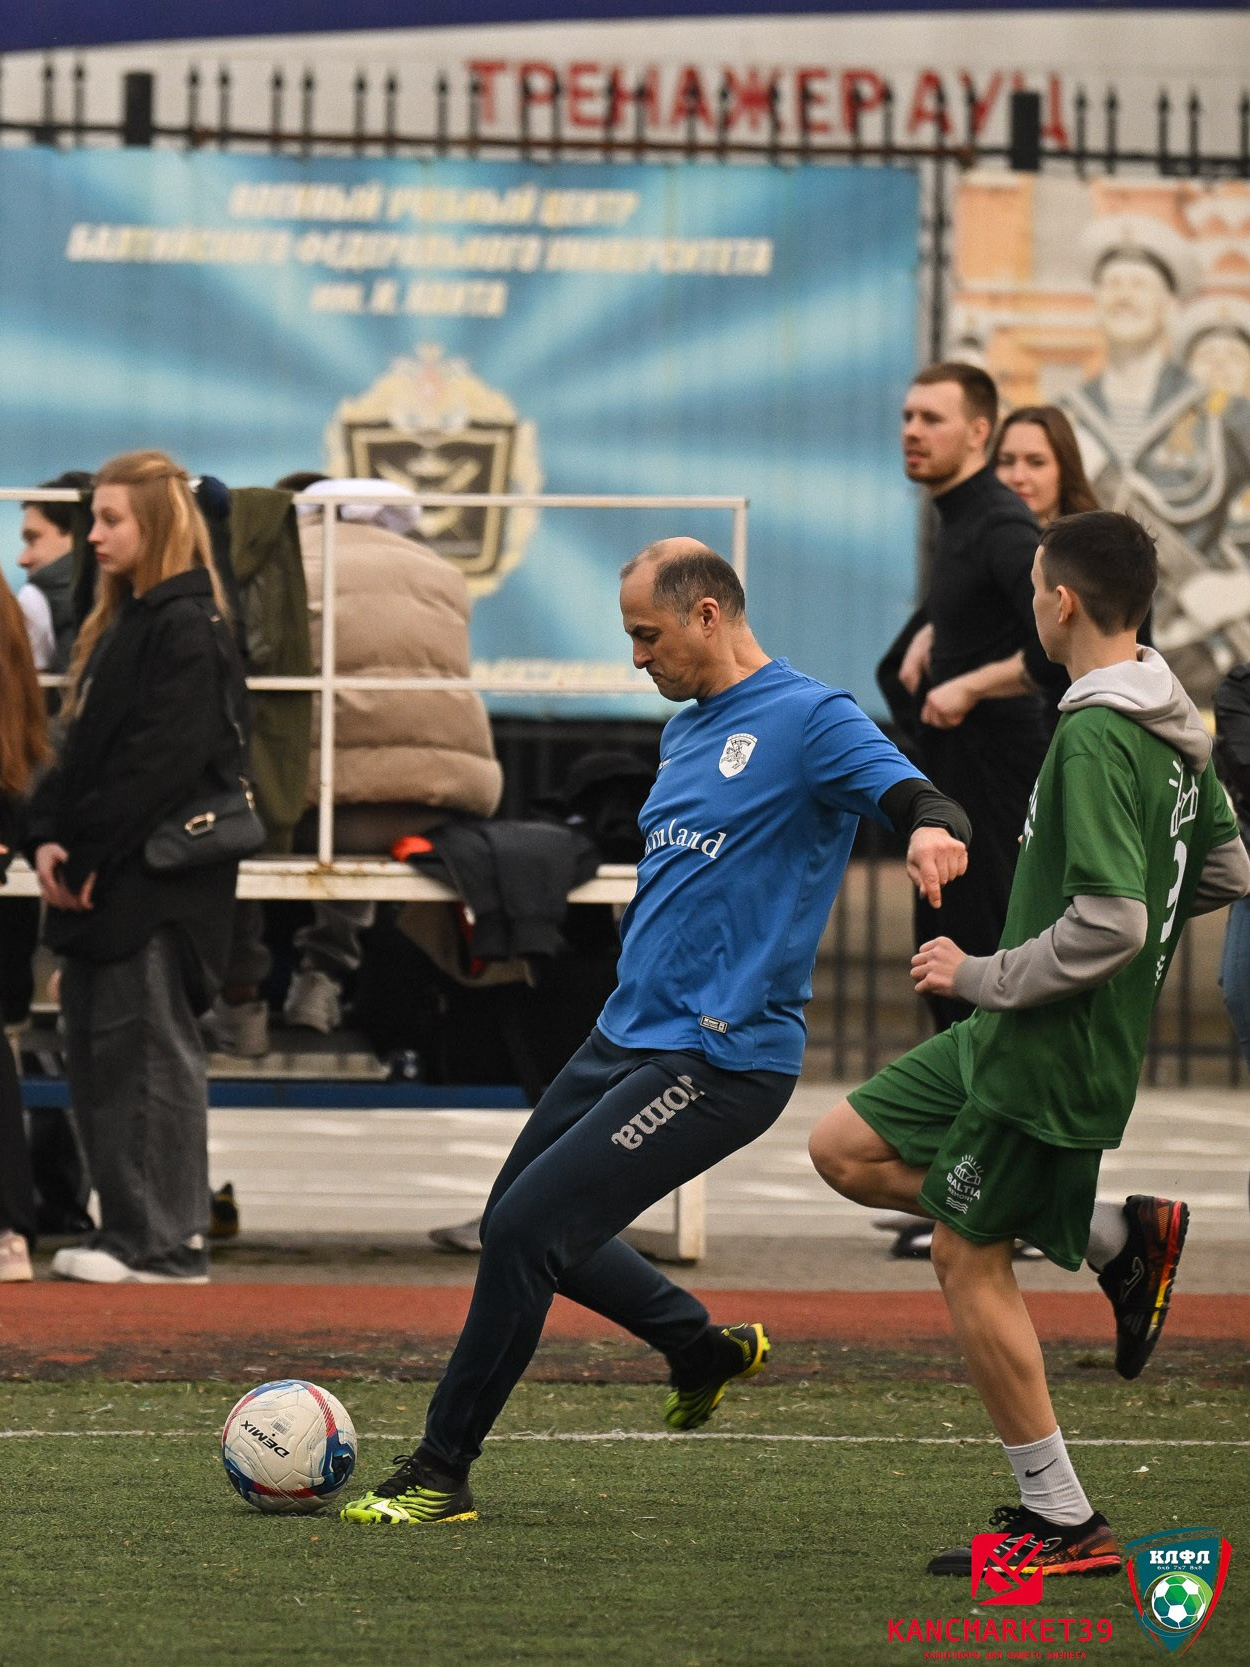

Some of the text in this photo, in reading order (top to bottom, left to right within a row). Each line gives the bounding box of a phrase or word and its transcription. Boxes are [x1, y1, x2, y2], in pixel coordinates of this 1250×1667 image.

[465, 60, 886, 135] ТРЕНАЖЕР
[644, 818, 726, 859] amland
[946, 1172, 981, 1200] BALTIA
[240, 1420, 290, 1458] DEMIX
